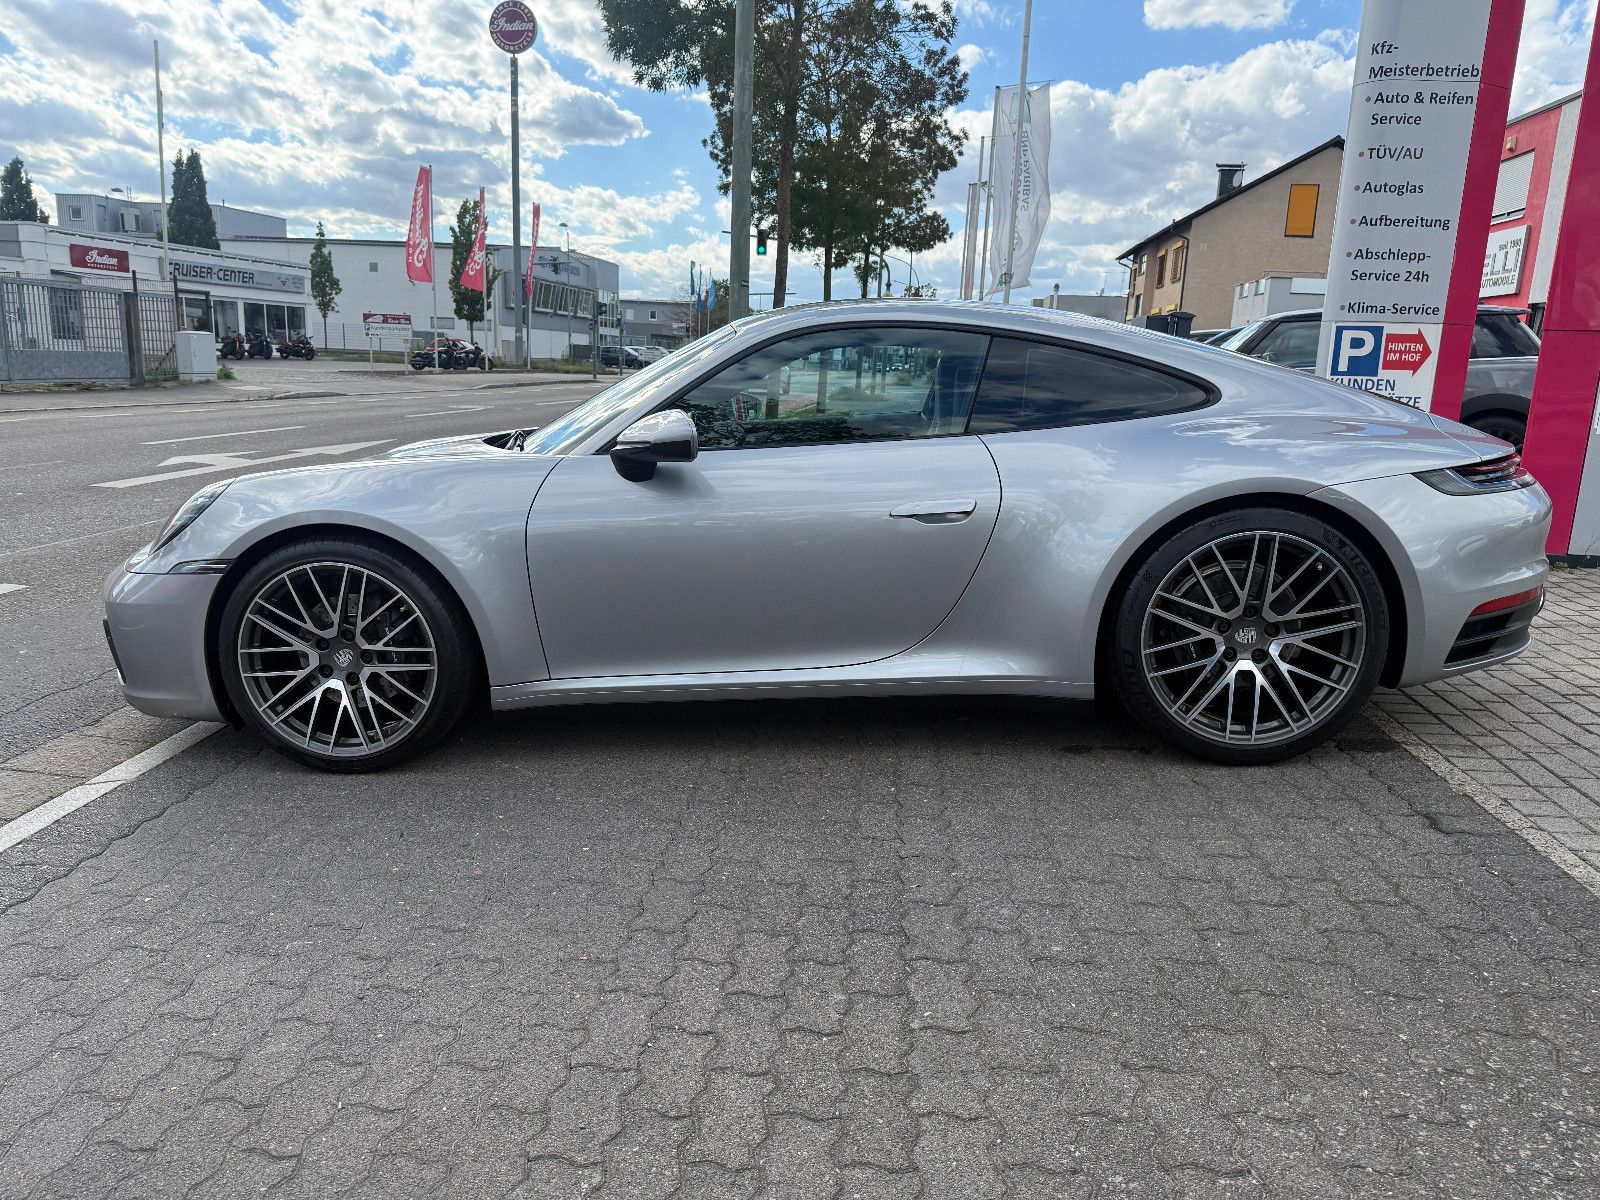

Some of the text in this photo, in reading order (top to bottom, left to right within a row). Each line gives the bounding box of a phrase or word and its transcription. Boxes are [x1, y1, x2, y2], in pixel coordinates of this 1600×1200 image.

[490, 17, 534, 32] Indian
[491, 32, 533, 51] MOTORCYCLE
[1371, 41, 1399, 56] Kfz-
[1368, 63, 1480, 79] Meisterbetrieb
[1373, 91, 1474, 105] Auto & Reifen
[1370, 112, 1422, 125] Service
[1367, 144, 1424, 161] TÜV/AU
[1361, 180, 1424, 197] Autoglas
[1358, 214, 1451, 231] Aufbereitung
[85, 250, 118, 265] Indian
[1353, 248, 1431, 264] Abschlepp-
[1350, 269, 1430, 283] Service 24h
[1481, 274, 1516, 289] UTOMOBILE
[1347, 301, 1440, 316] Klima-Service
[1338, 329, 1375, 372] P
[1388, 342, 1424, 352] HINTEN
[1386, 352, 1422, 362] IM HOF
